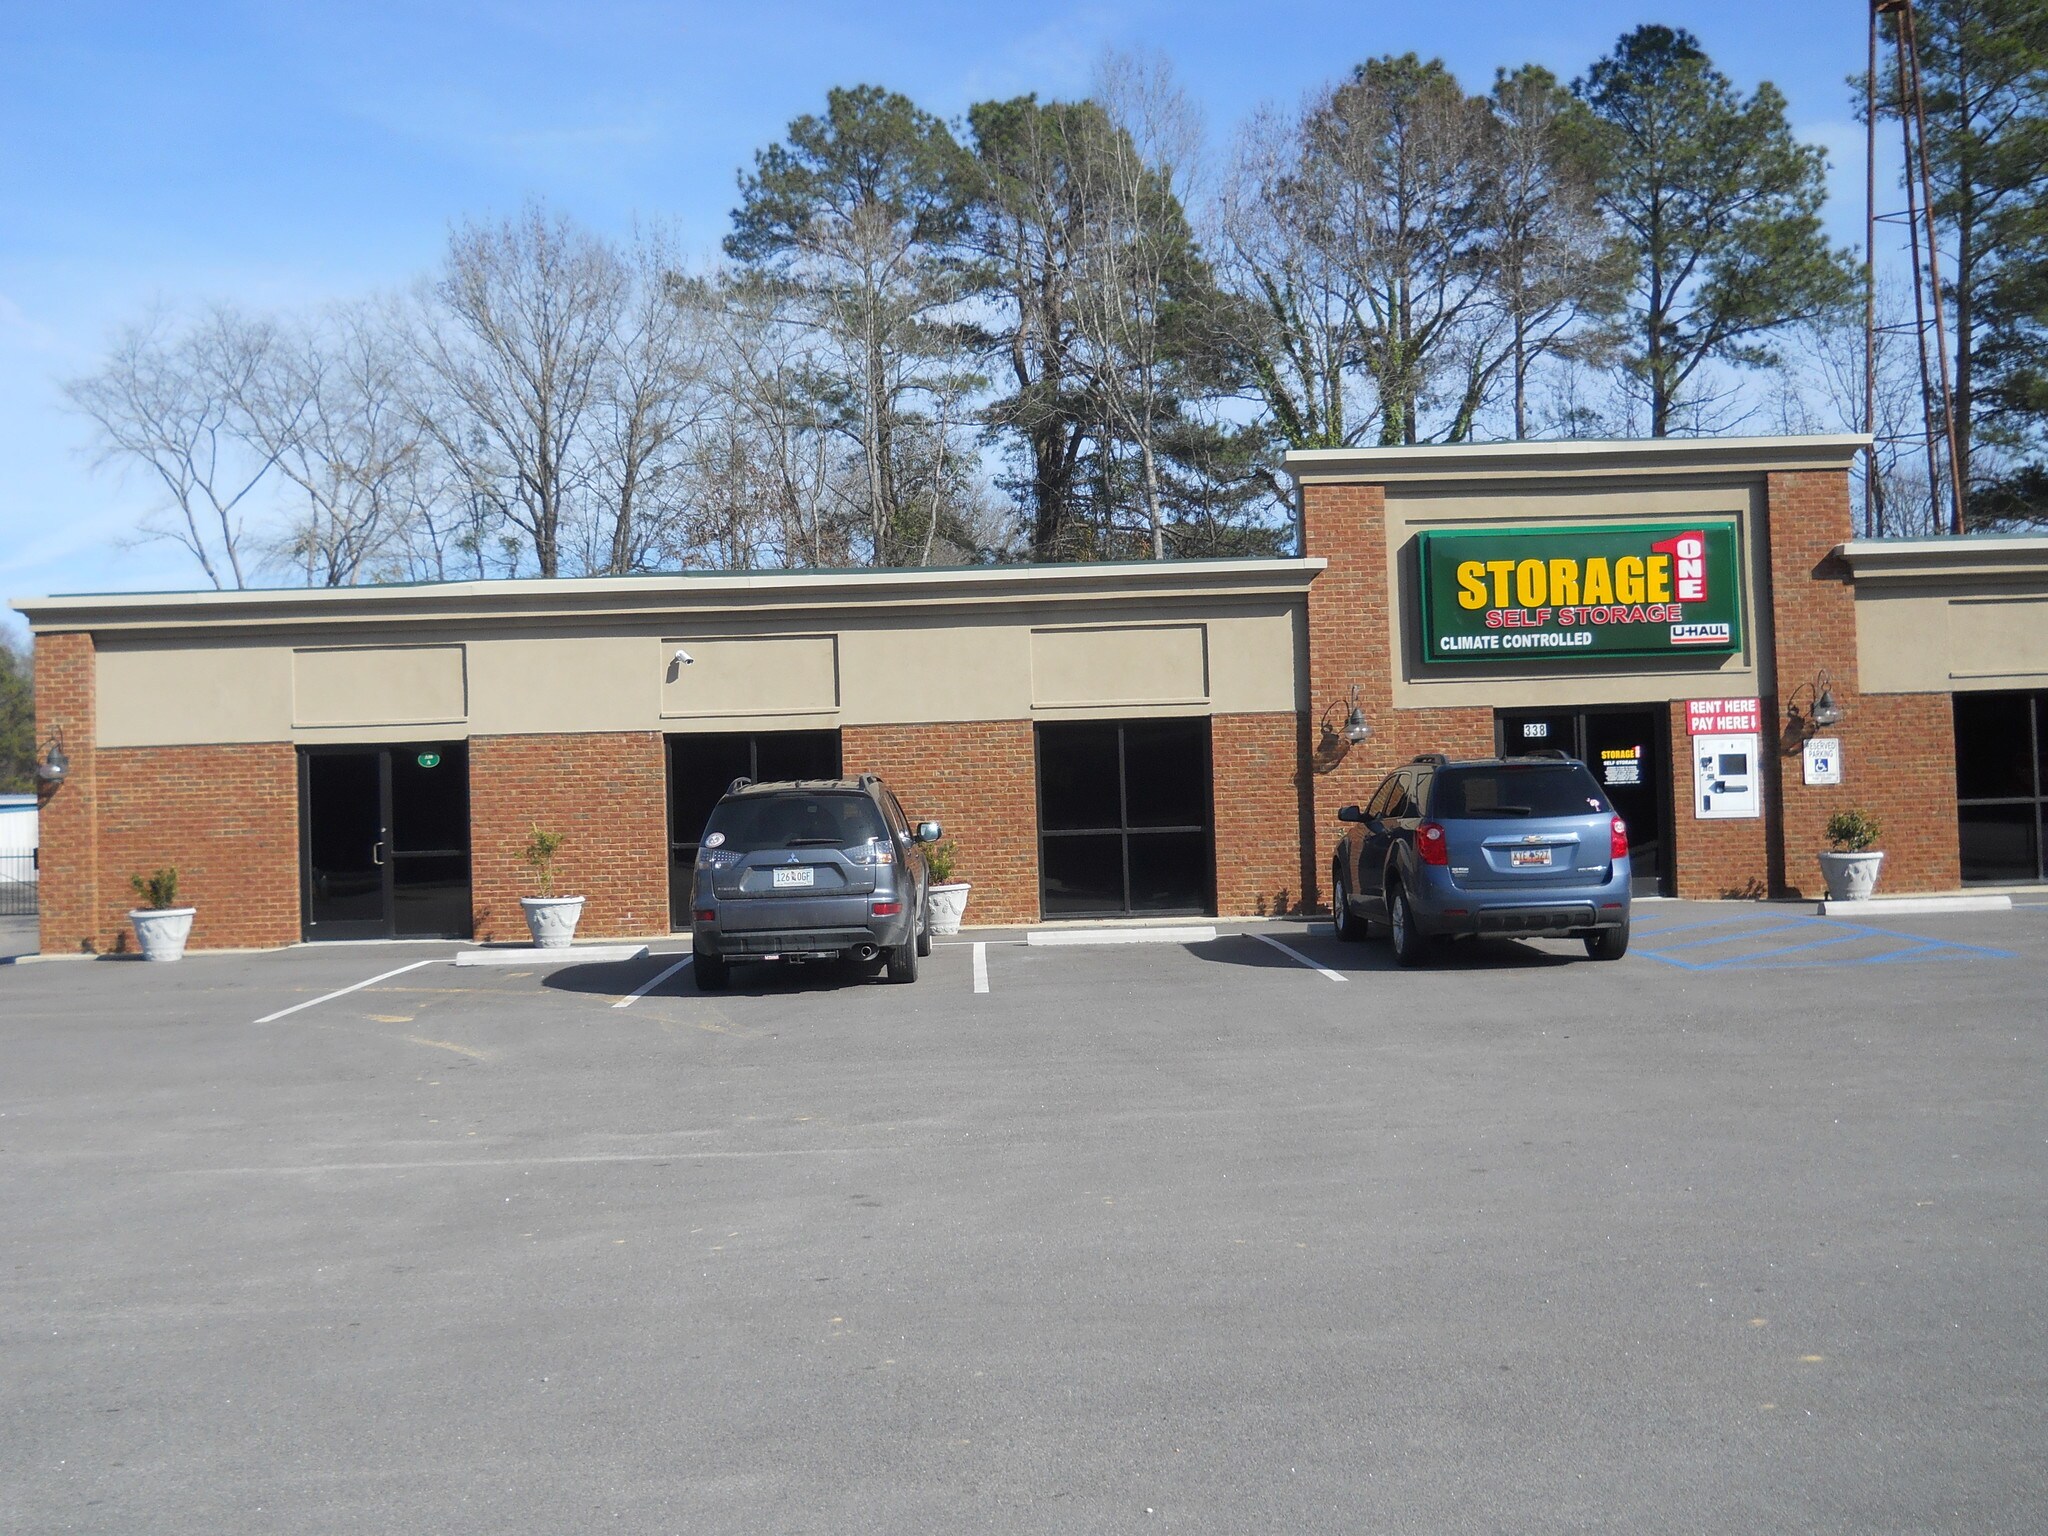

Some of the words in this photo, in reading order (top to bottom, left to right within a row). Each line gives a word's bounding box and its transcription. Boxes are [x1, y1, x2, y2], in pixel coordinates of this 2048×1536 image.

[1676, 539, 1703, 599] ONE
[1457, 554, 1670, 609] STORAGE
[1485, 608, 1552, 628] SELF
[1558, 603, 1683, 626] STORAGE
[1672, 625, 1728, 637] U-HAUL
[1440, 635, 1500, 651] CLIMATE
[1502, 632, 1592, 649] CONTROLLED
[1690, 700, 1722, 714] RENT
[1724, 699, 1756, 713] HERE
[1525, 725, 1545, 736] 338
[1691, 716, 1714, 731] PAY
[1716, 715, 1749, 730] HERE
[1601, 750, 1635, 759] STORAGE
[777, 872, 790, 882] 126
